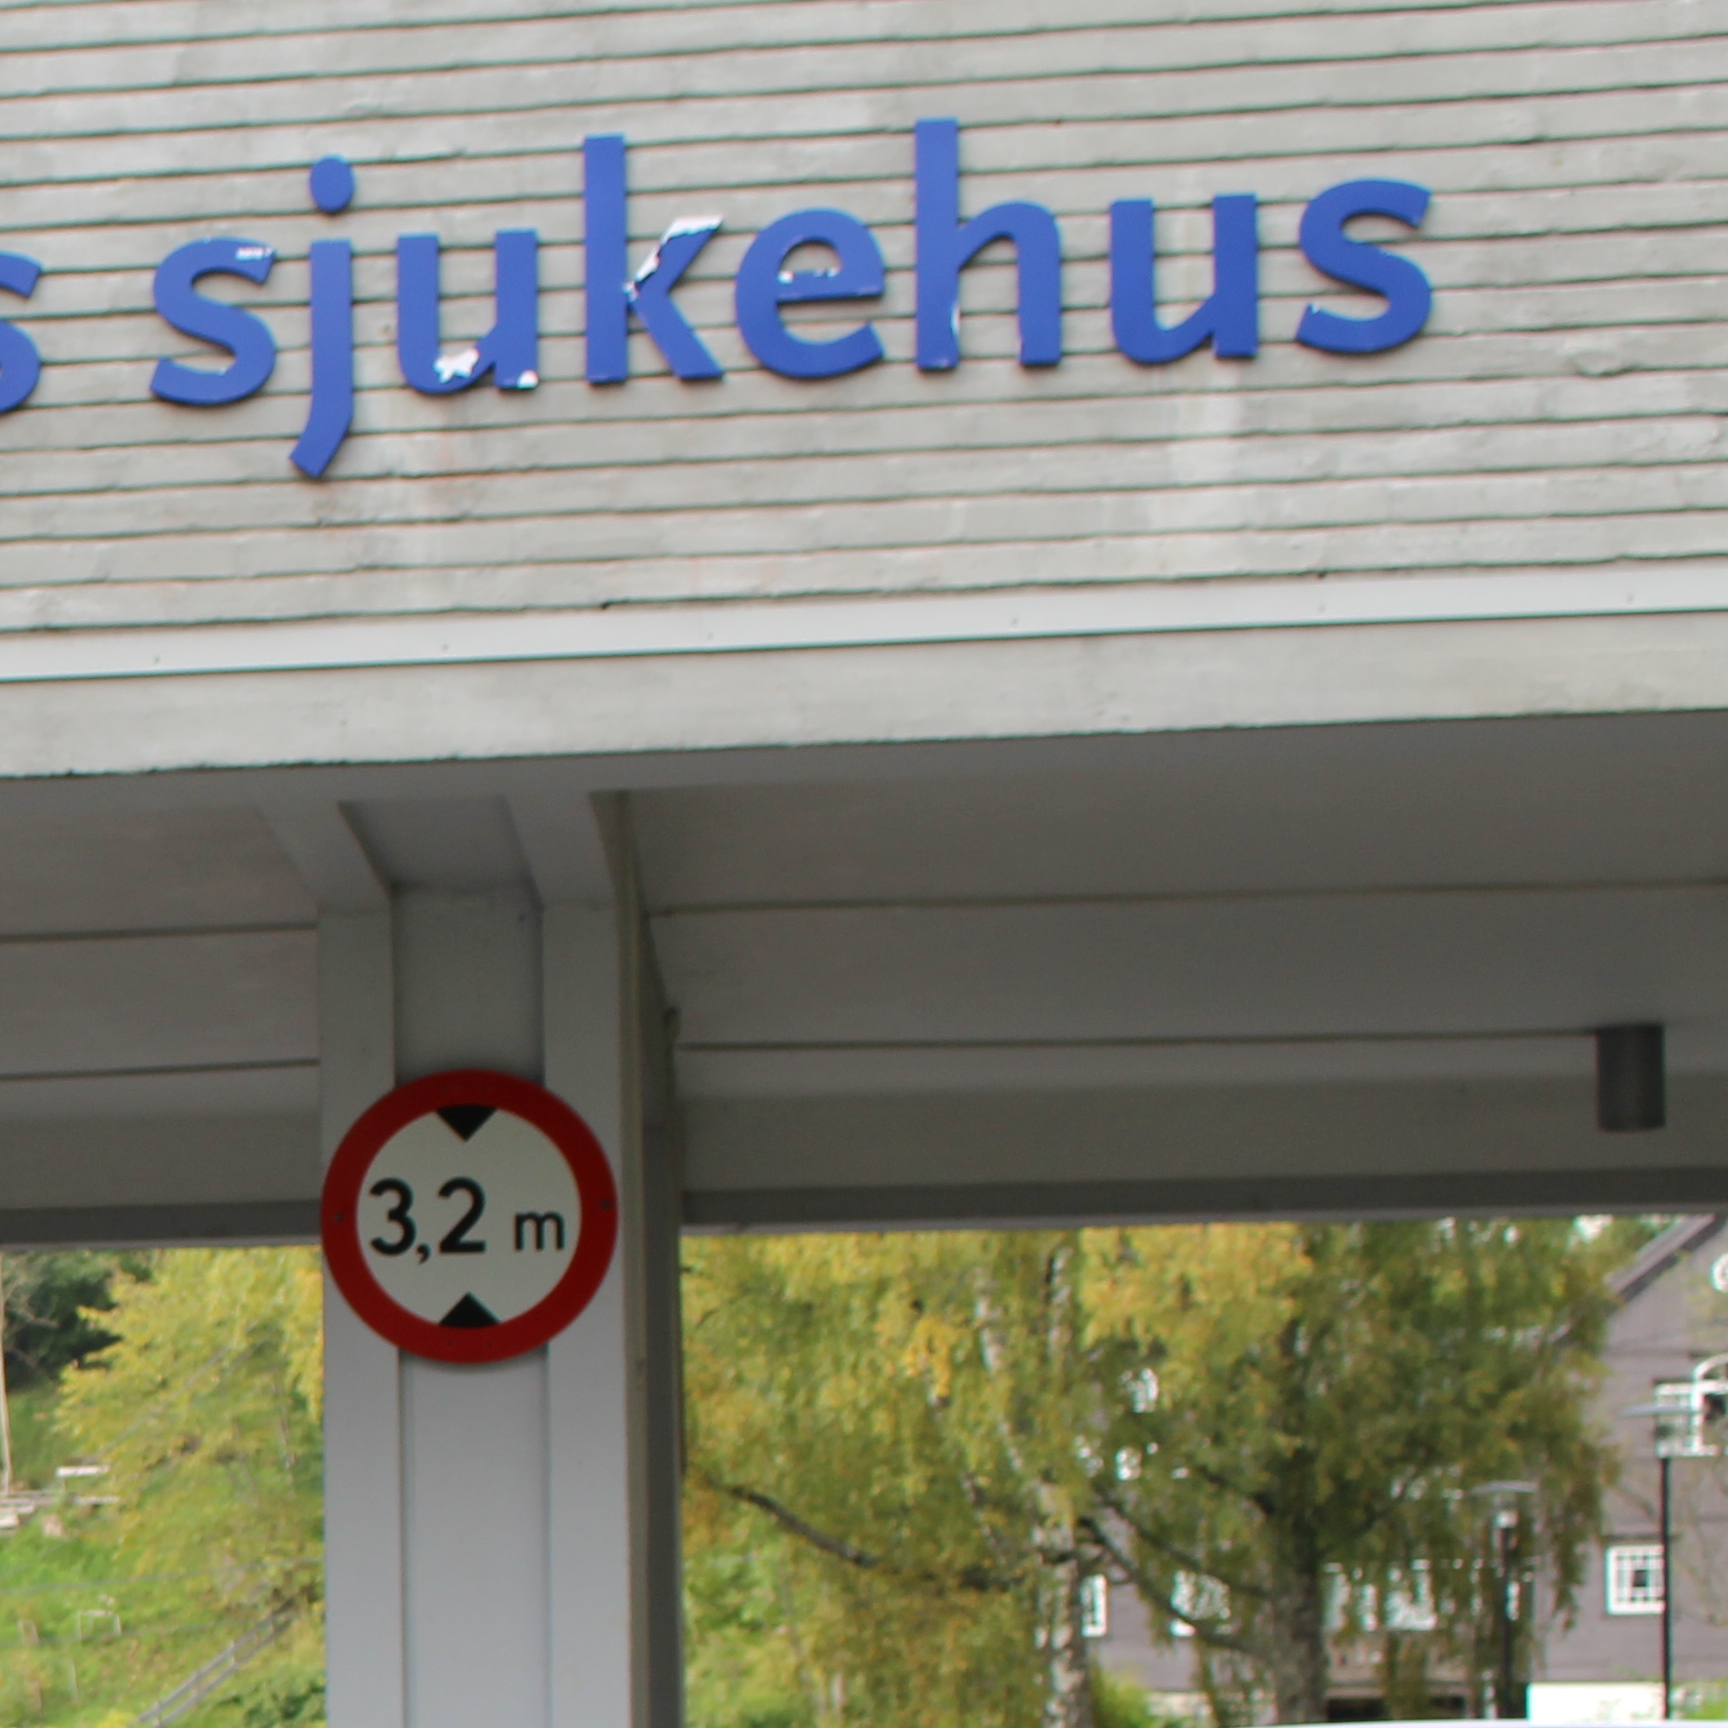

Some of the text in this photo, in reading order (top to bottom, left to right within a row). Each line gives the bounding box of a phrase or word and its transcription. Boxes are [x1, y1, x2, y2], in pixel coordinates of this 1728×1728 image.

[149, 117, 1433, 479] sjukehus
[369, 1176, 566, 1265] 3,2 m
